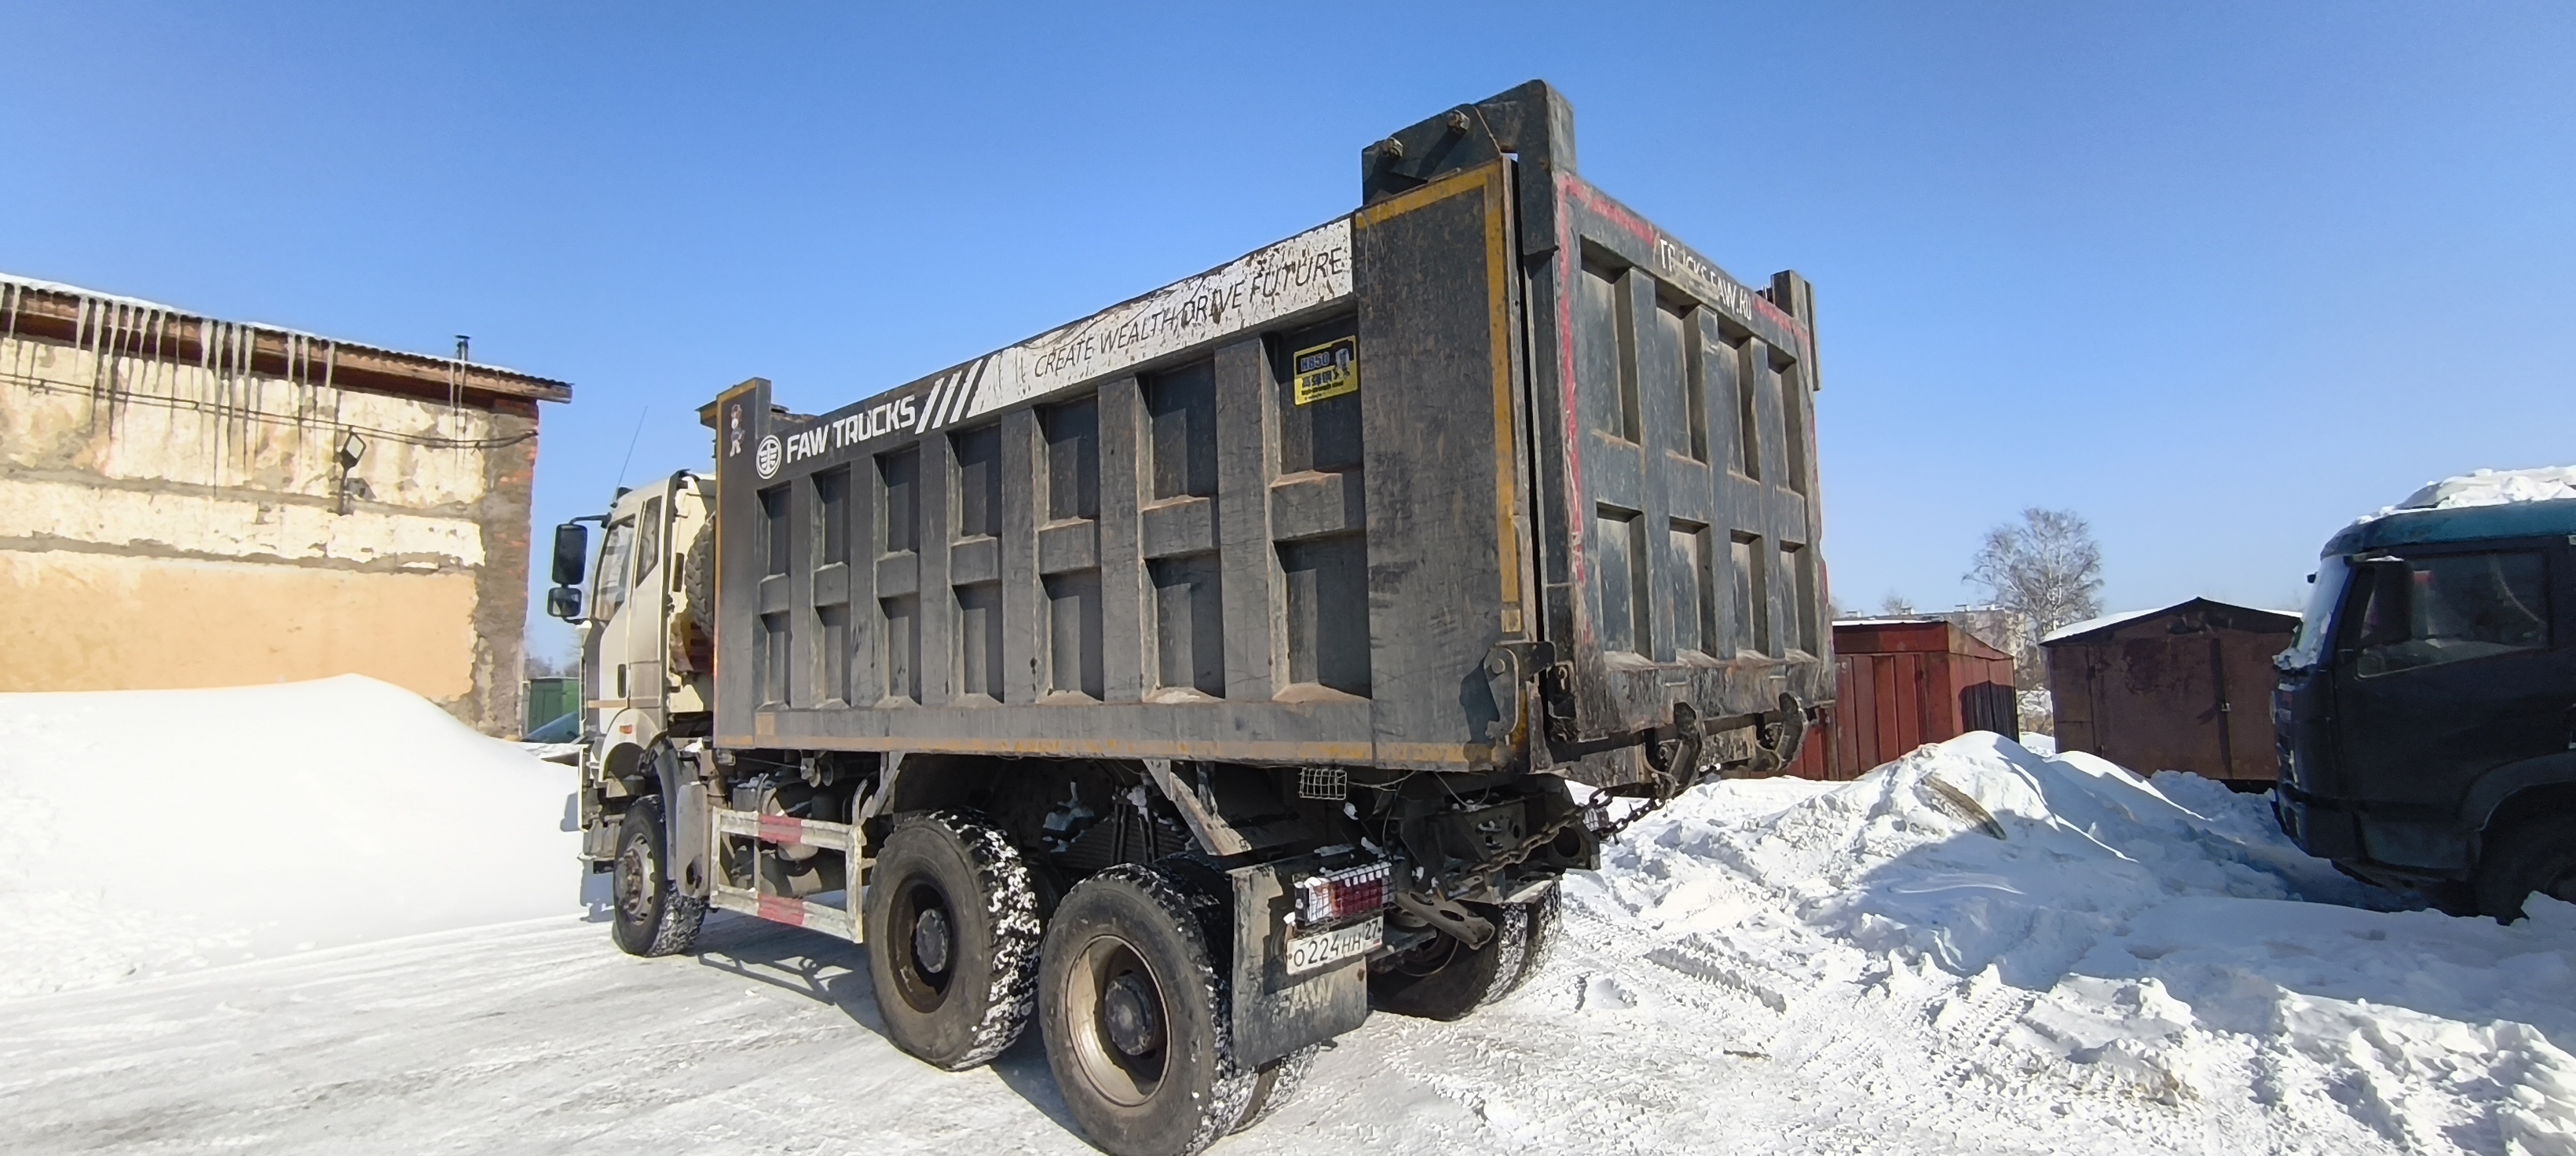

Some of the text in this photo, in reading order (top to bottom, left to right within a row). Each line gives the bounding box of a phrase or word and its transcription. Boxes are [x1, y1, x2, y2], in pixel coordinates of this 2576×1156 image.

[1034, 246, 1344, 379] CREATE WEALTH DRIVE FUTURE
[787, 394, 916, 464] FAW TRUCKS
